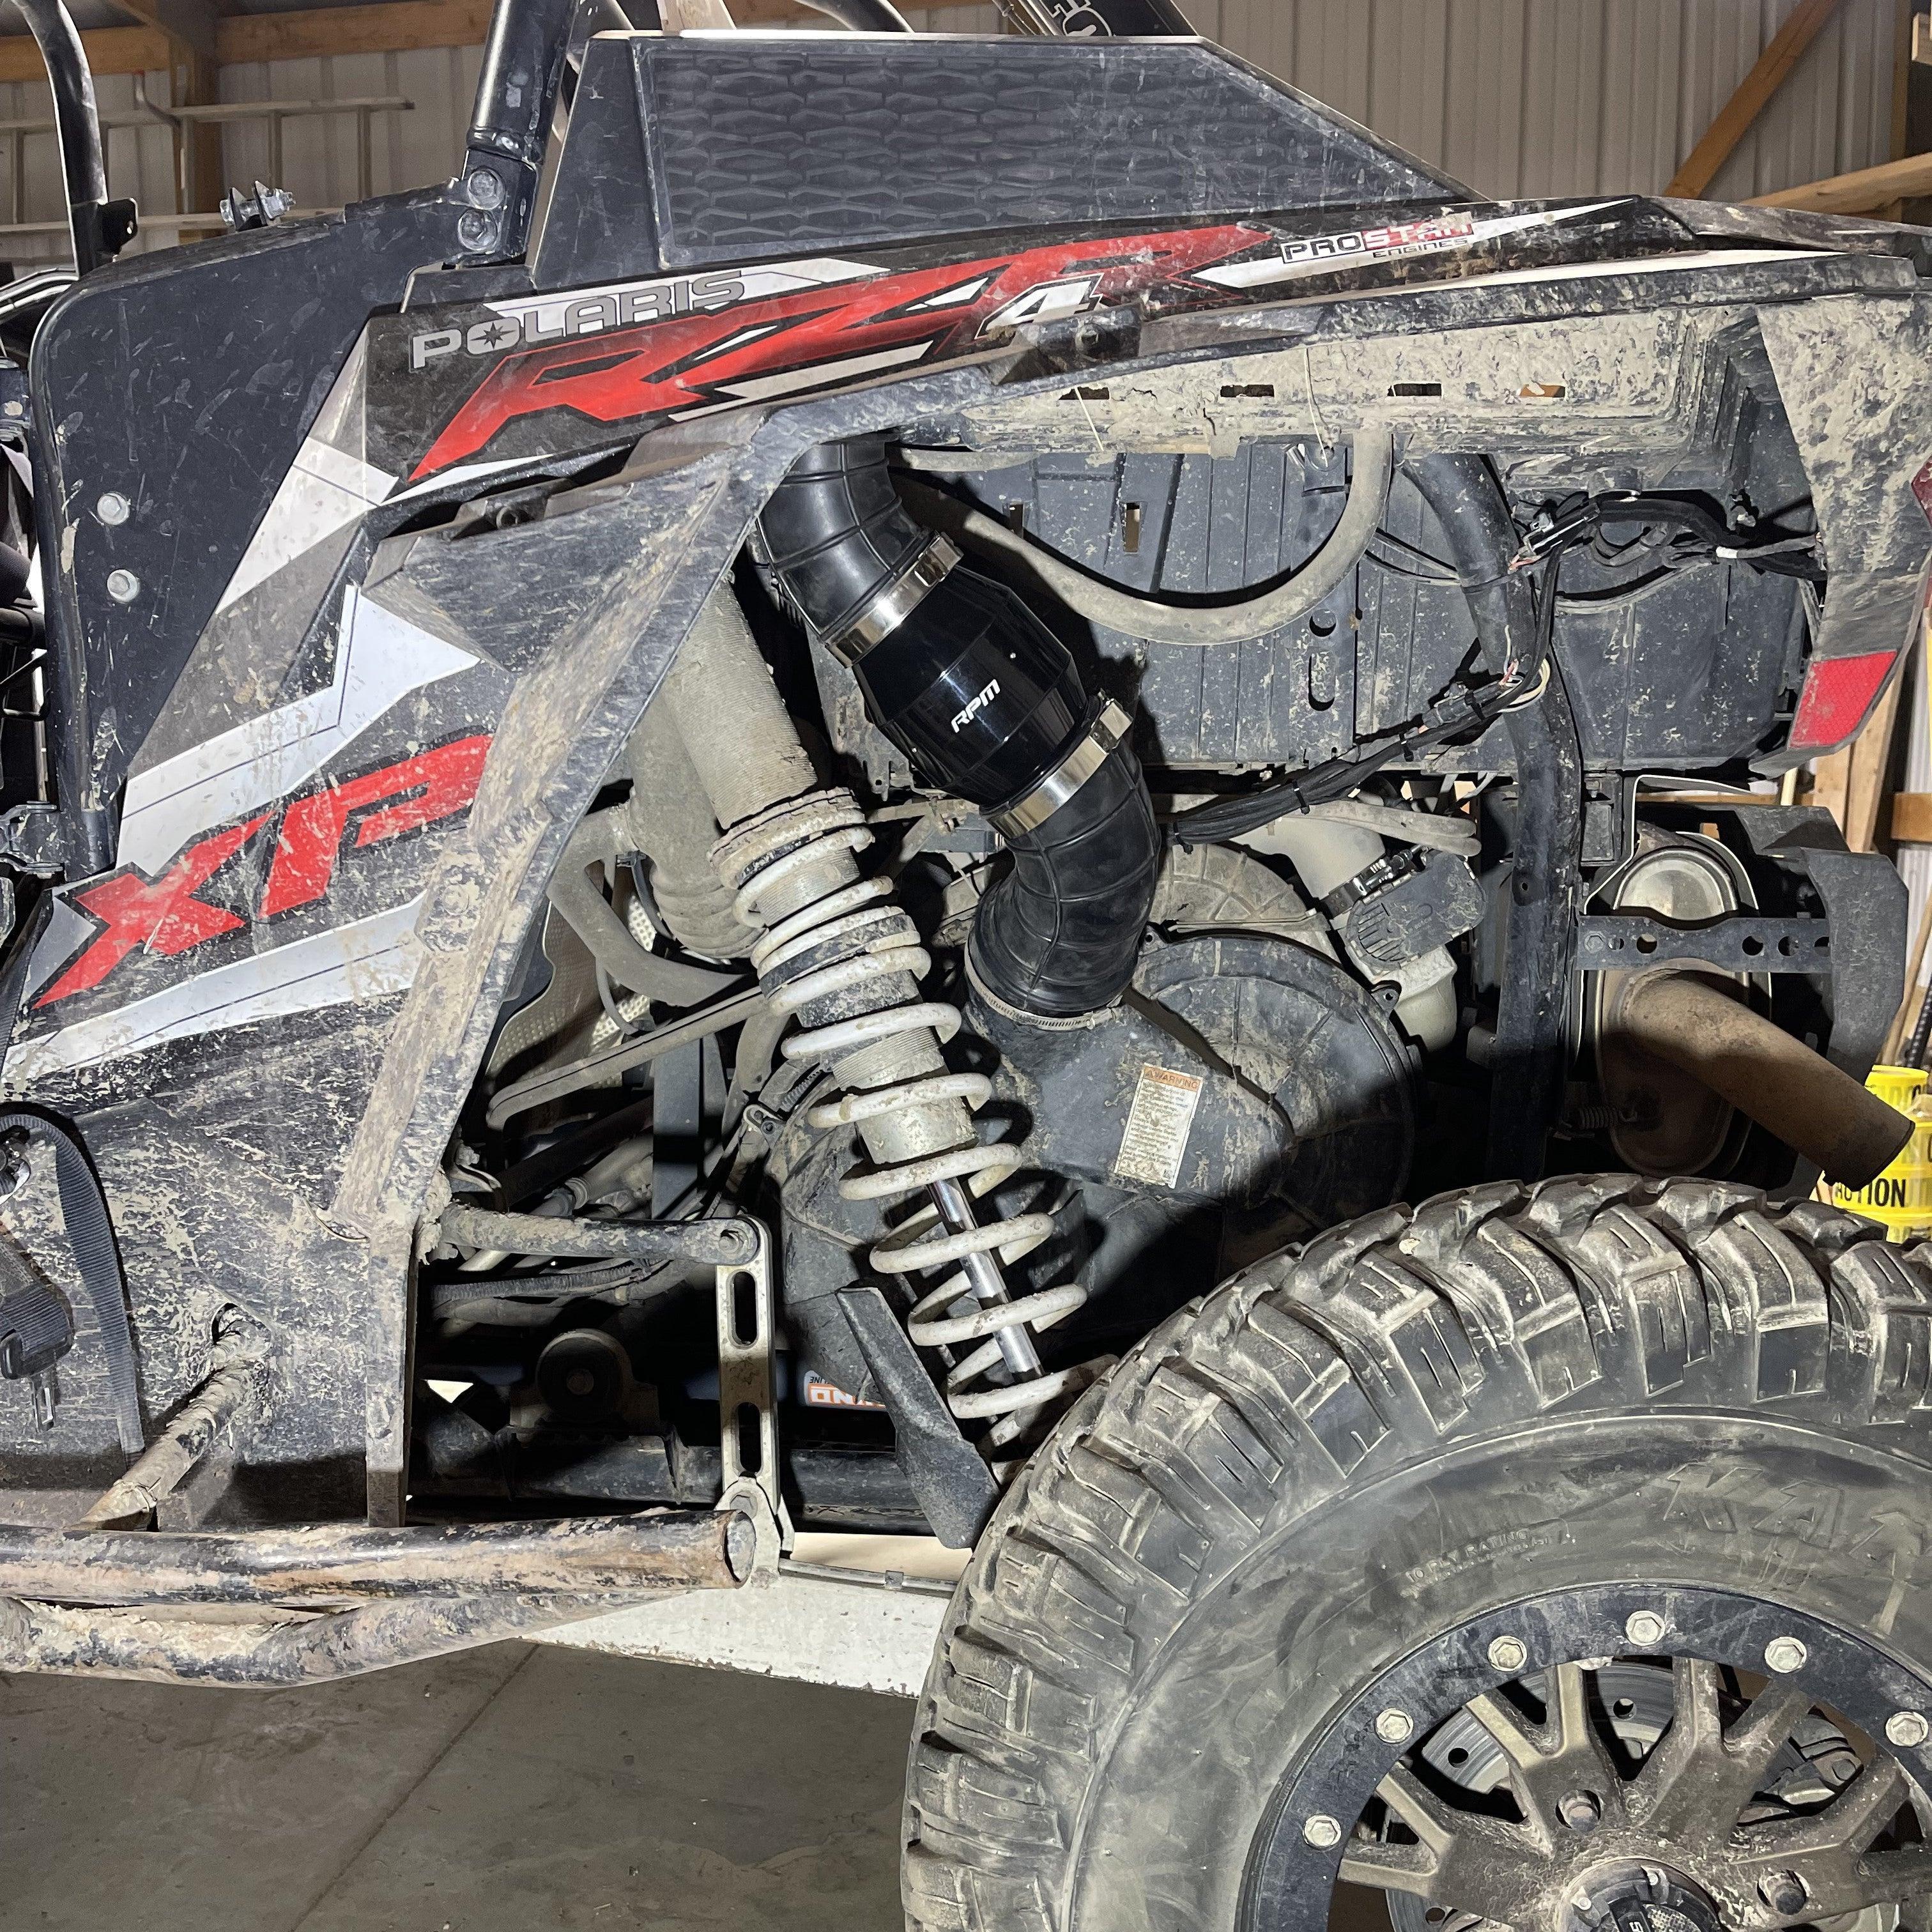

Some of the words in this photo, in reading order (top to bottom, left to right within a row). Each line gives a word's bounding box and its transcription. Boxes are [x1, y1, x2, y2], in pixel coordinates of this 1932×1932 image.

[1373, 236, 1468, 258] ENGINES
[409, 269, 745, 373] POLARIS
[950, 678, 1000, 733] RPM
[32, 733, 493, 1009] XP
[1153, 1071, 1199, 1089] WARNING
[1406, 1567, 1425, 1583] 10
[1463, 1528, 1529, 1558] RATING
